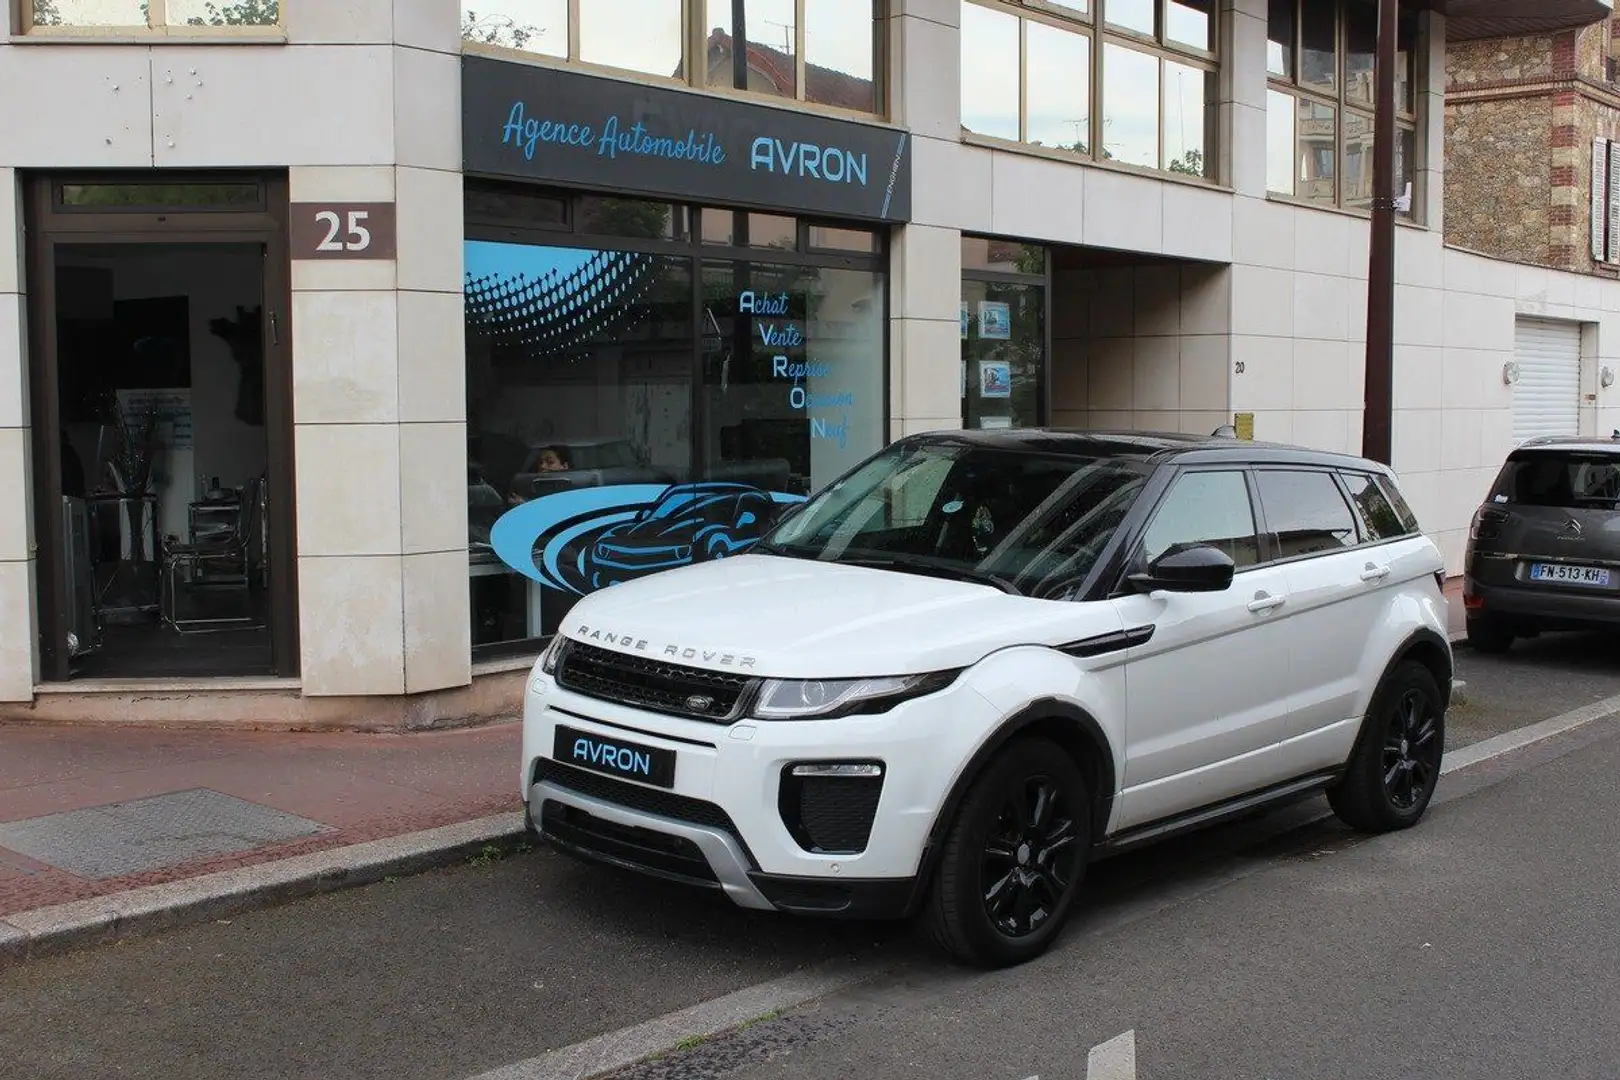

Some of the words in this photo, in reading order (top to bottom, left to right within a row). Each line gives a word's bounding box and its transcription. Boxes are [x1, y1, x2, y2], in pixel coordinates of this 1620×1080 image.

[502, 101, 595, 161] Agence
[597, 115, 726, 165] Automobile
[750, 136, 867, 186] AVRON
[315, 210, 371, 251] 25
[739, 291, 789, 315] Achat
[758, 323, 802, 346] Vente
[1235, 361, 1245, 374] 20
[1540, 565, 1600, 582] FN-513-KH
[577, 625, 649, 650] RANGE
[663, 643, 756, 669] ROVER
[573, 738, 650, 775] AVRON
